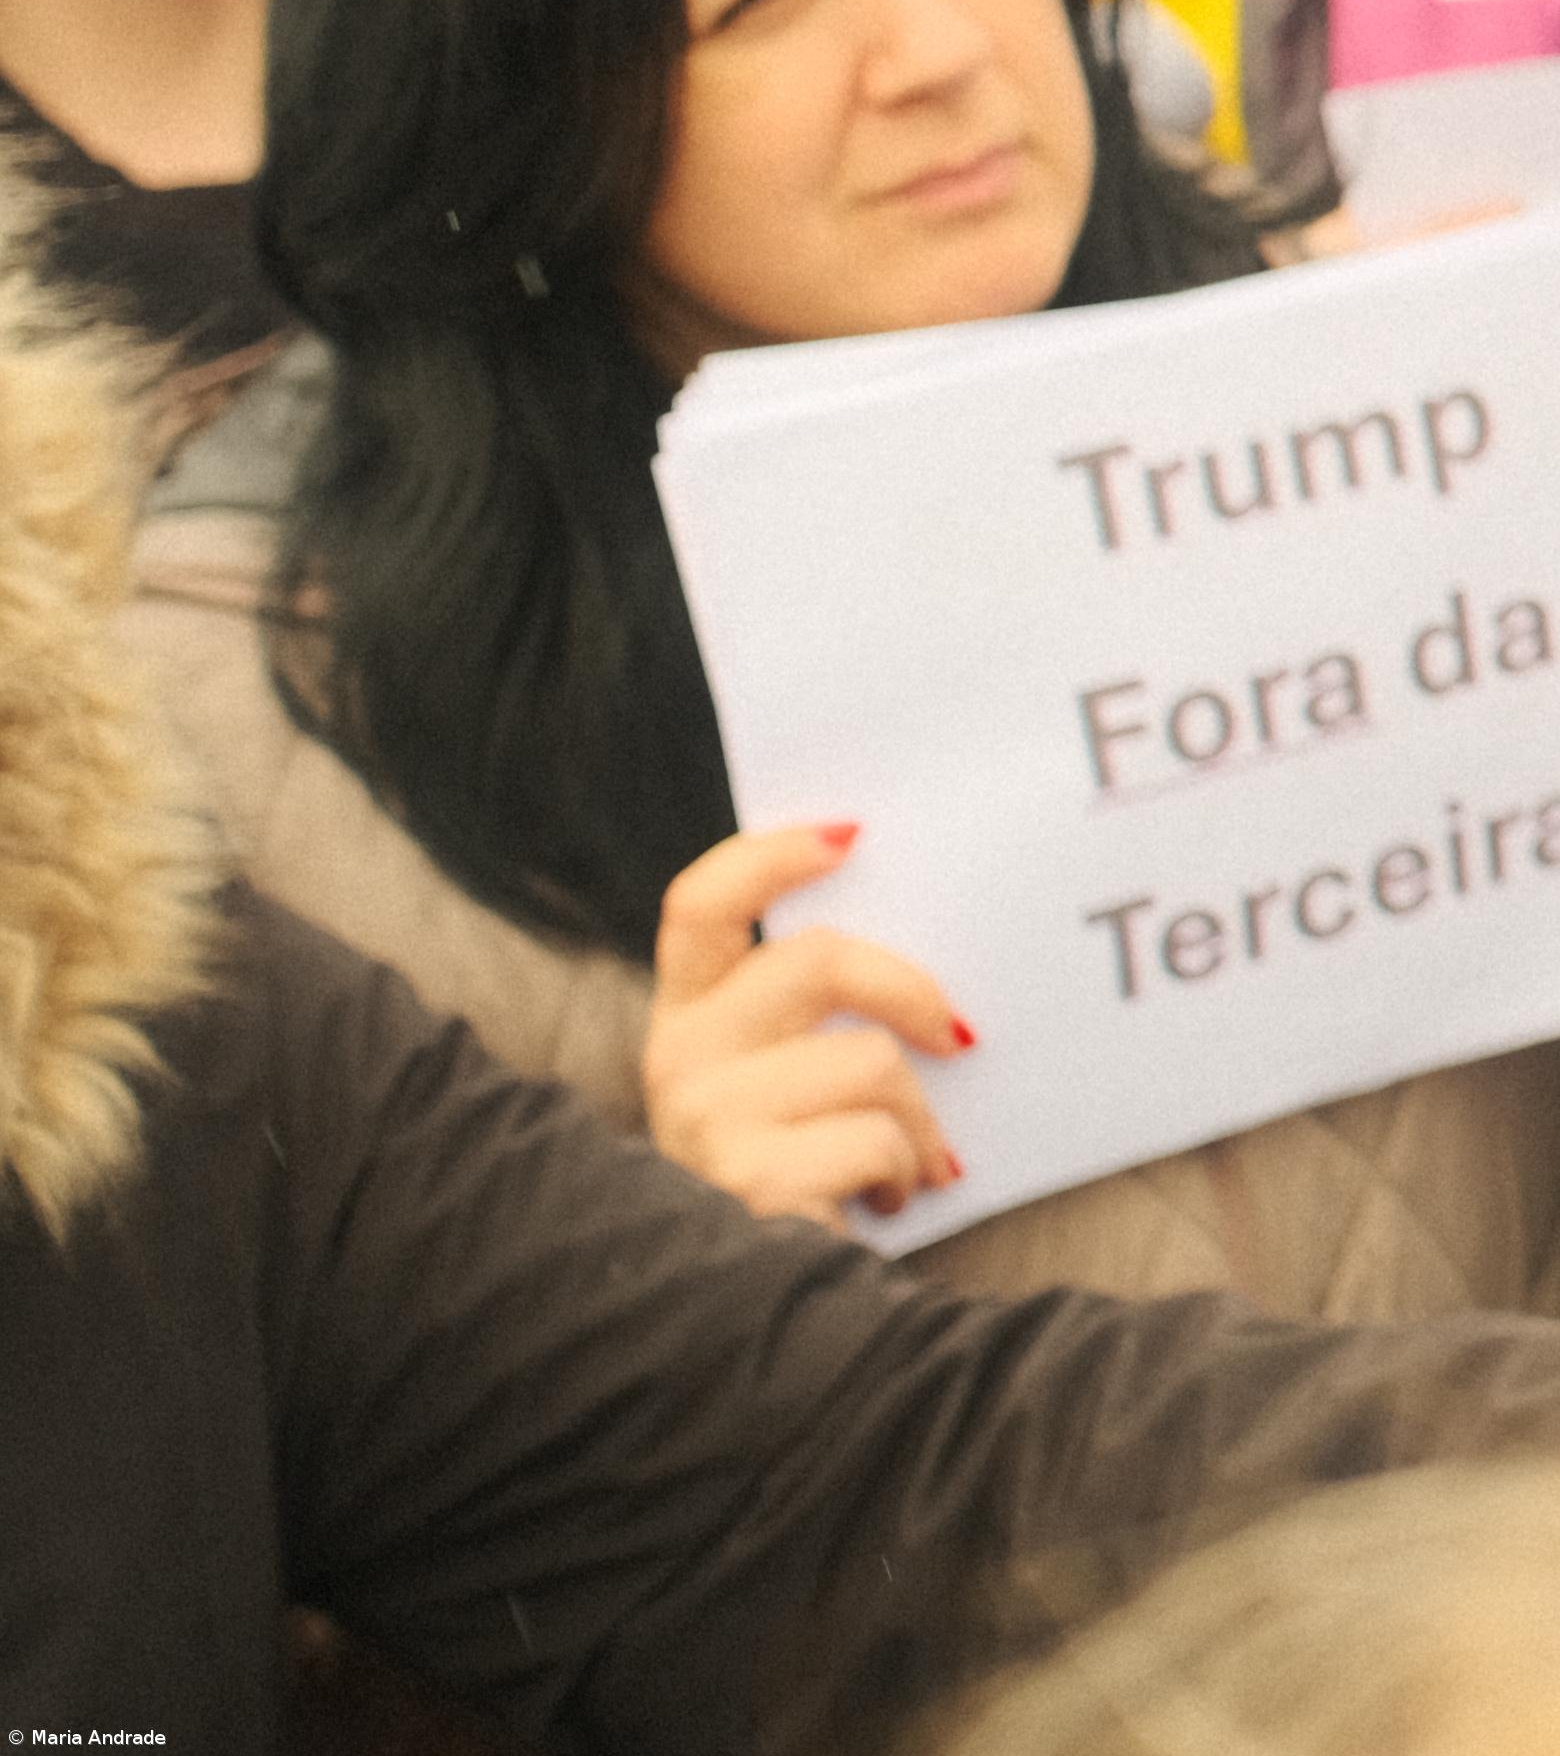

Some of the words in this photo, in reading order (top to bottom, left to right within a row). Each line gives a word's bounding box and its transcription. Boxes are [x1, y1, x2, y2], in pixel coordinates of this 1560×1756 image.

[1060, 386, 1493, 554] Trump
[1077, 651, 1368, 790] Fora
[1408, 589, 1556, 697] da
